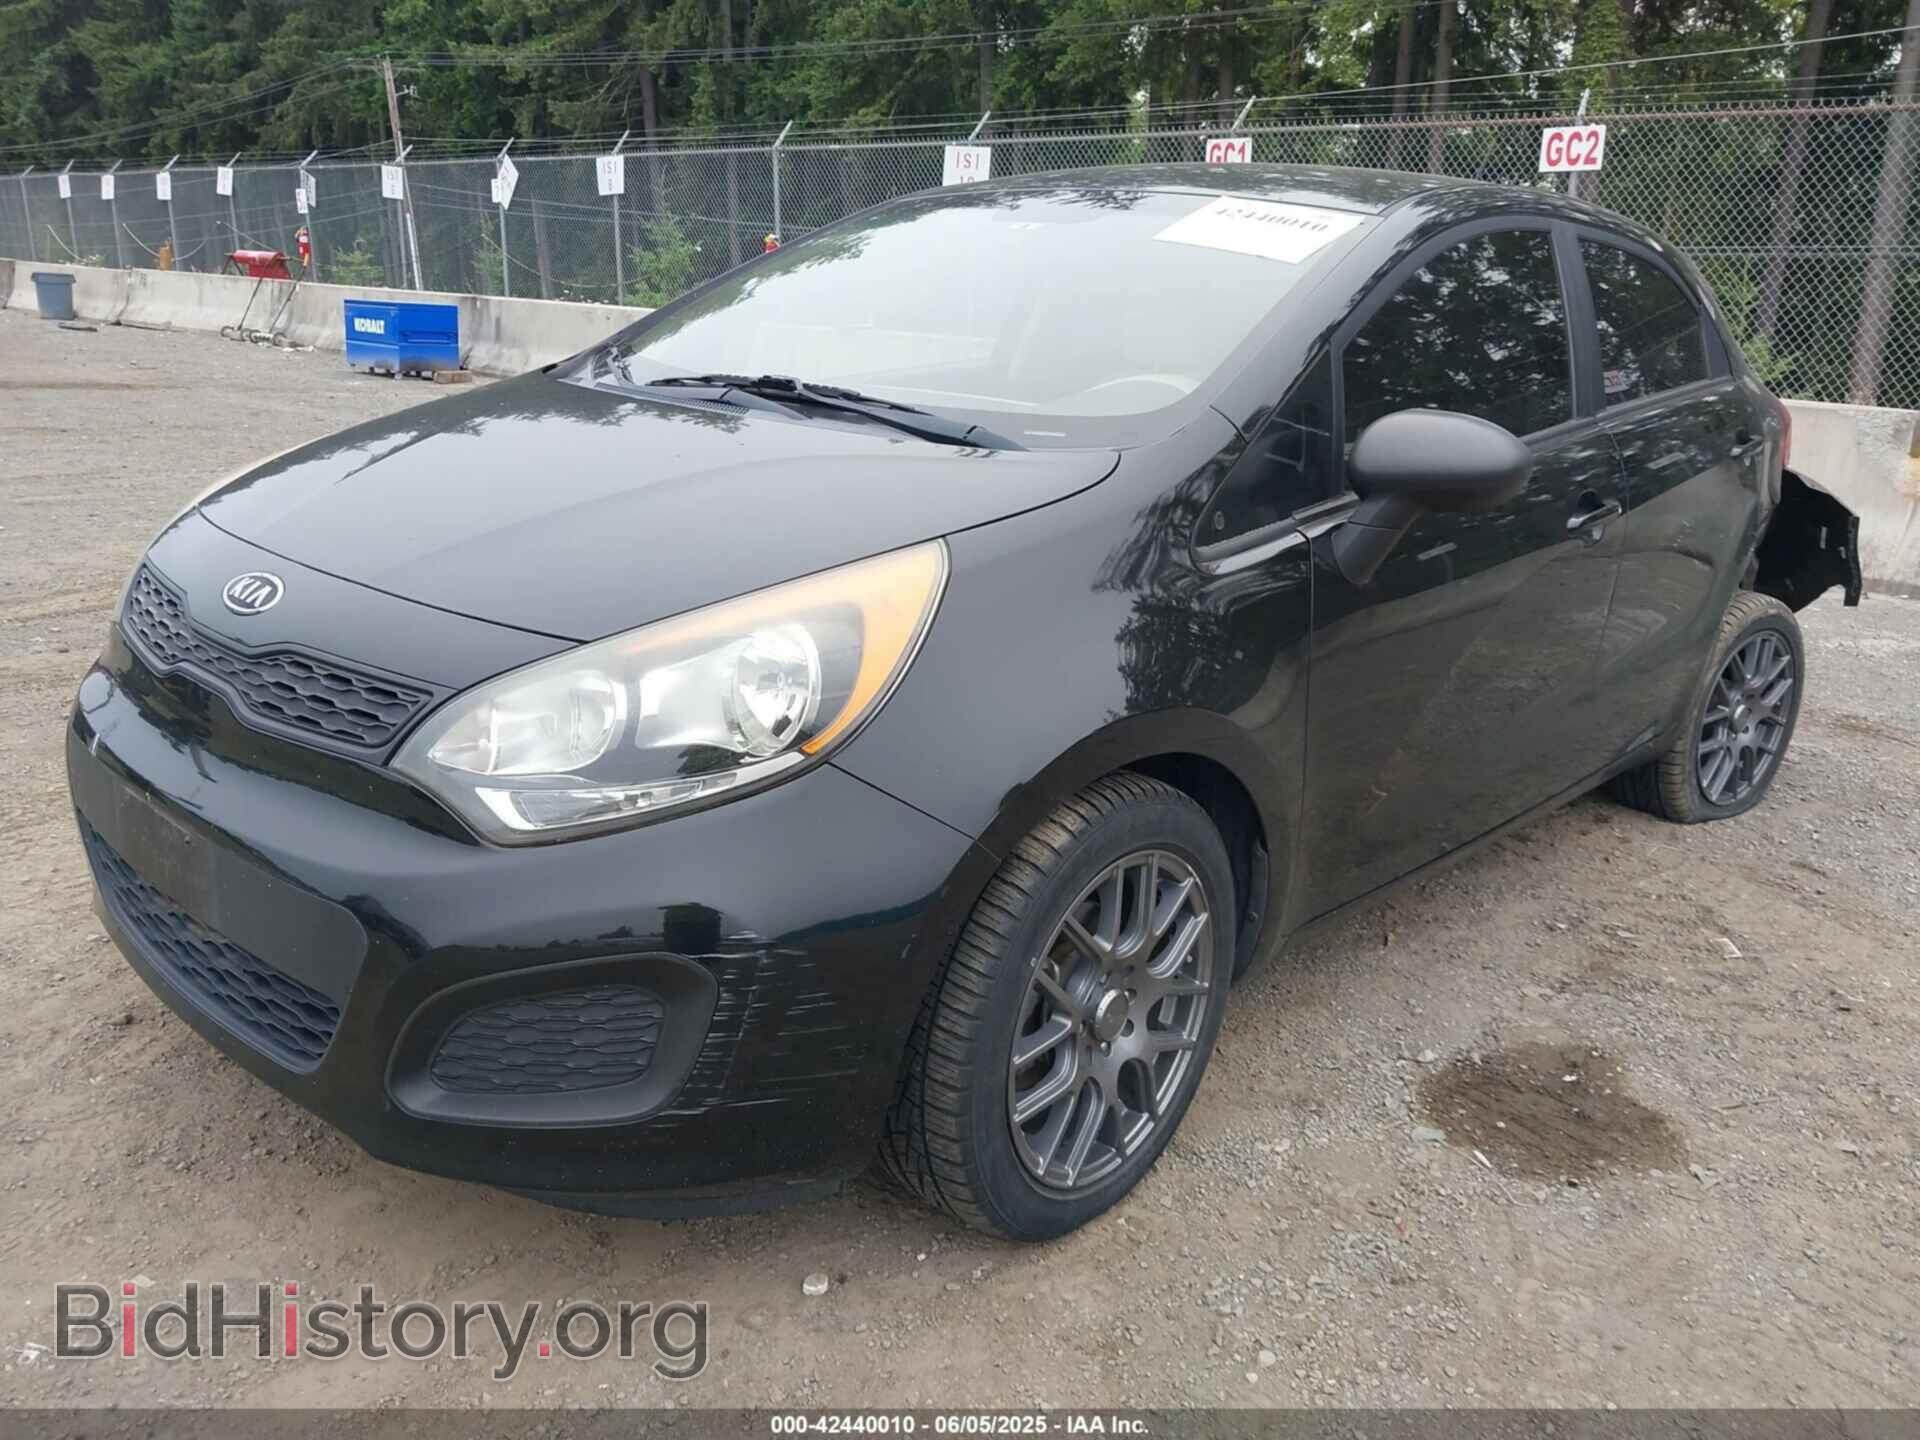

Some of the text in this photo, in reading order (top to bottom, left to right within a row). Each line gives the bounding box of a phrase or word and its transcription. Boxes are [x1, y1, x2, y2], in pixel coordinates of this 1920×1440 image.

[1209, 142, 1246, 163] GC1
[1546, 130, 1599, 167] GC2
[227, 576, 273, 608] KIA
